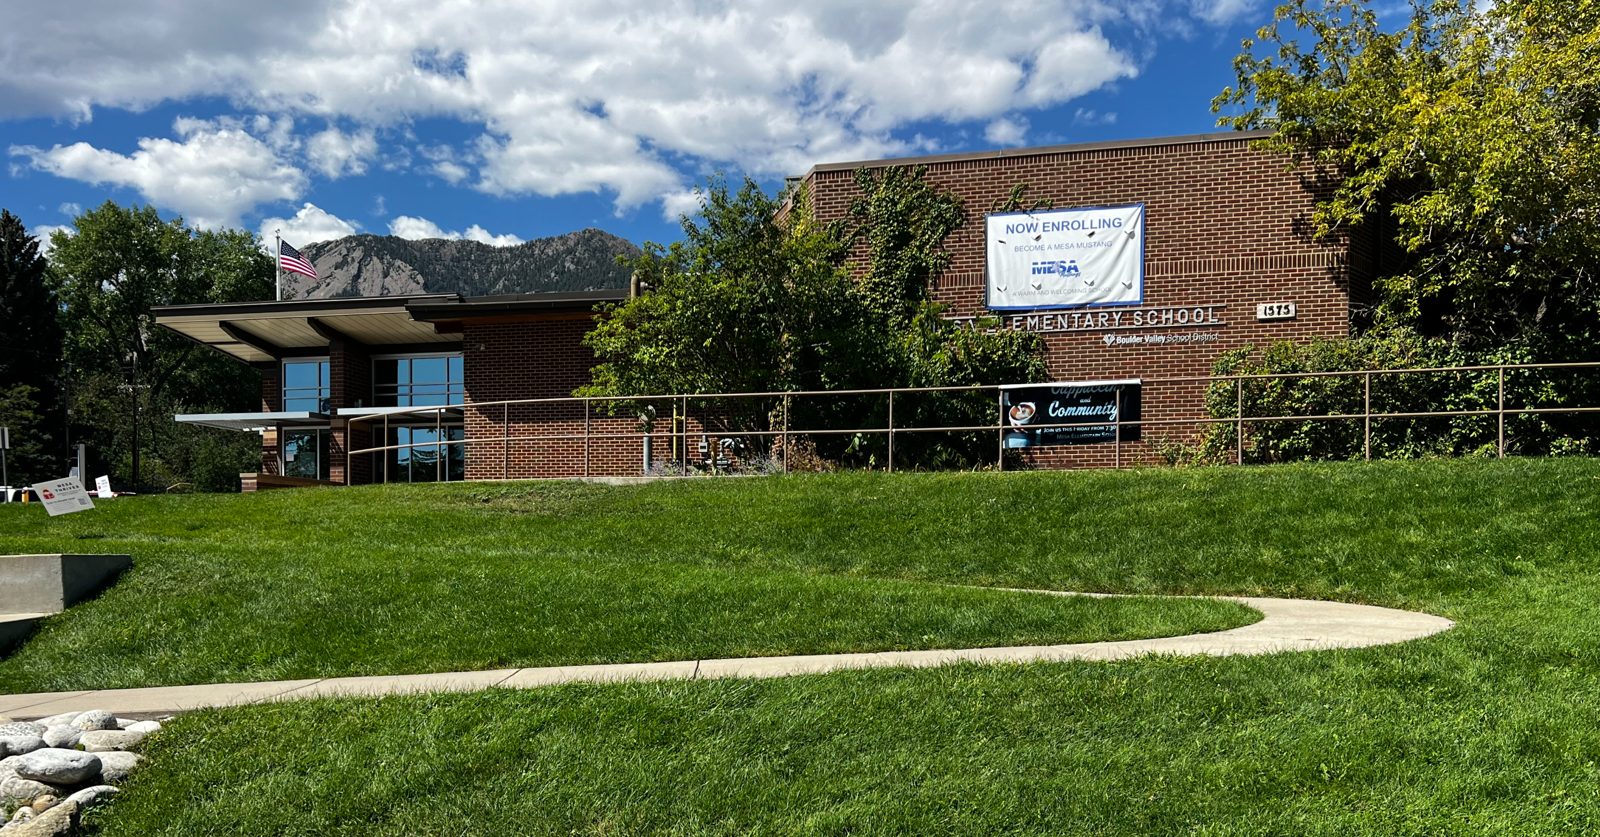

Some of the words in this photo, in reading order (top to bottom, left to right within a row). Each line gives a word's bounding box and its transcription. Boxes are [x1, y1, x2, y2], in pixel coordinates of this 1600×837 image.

[1006, 222, 1039, 234] NOW
[1042, 217, 1123, 232] ENROLLING
[1014, 244, 1046, 252] BECOME
[1076, 240, 1113, 249] MUSTANG
[1133, 307, 1219, 326] SCHOOL
[1263, 304, 1290, 316] 1575
[1116, 335, 1143, 344] Boulder
[1144, 334, 1166, 344] Valley
[1166, 333, 1192, 344] School
[1193, 332, 1219, 342] District
[1049, 401, 1117, 420] Community
